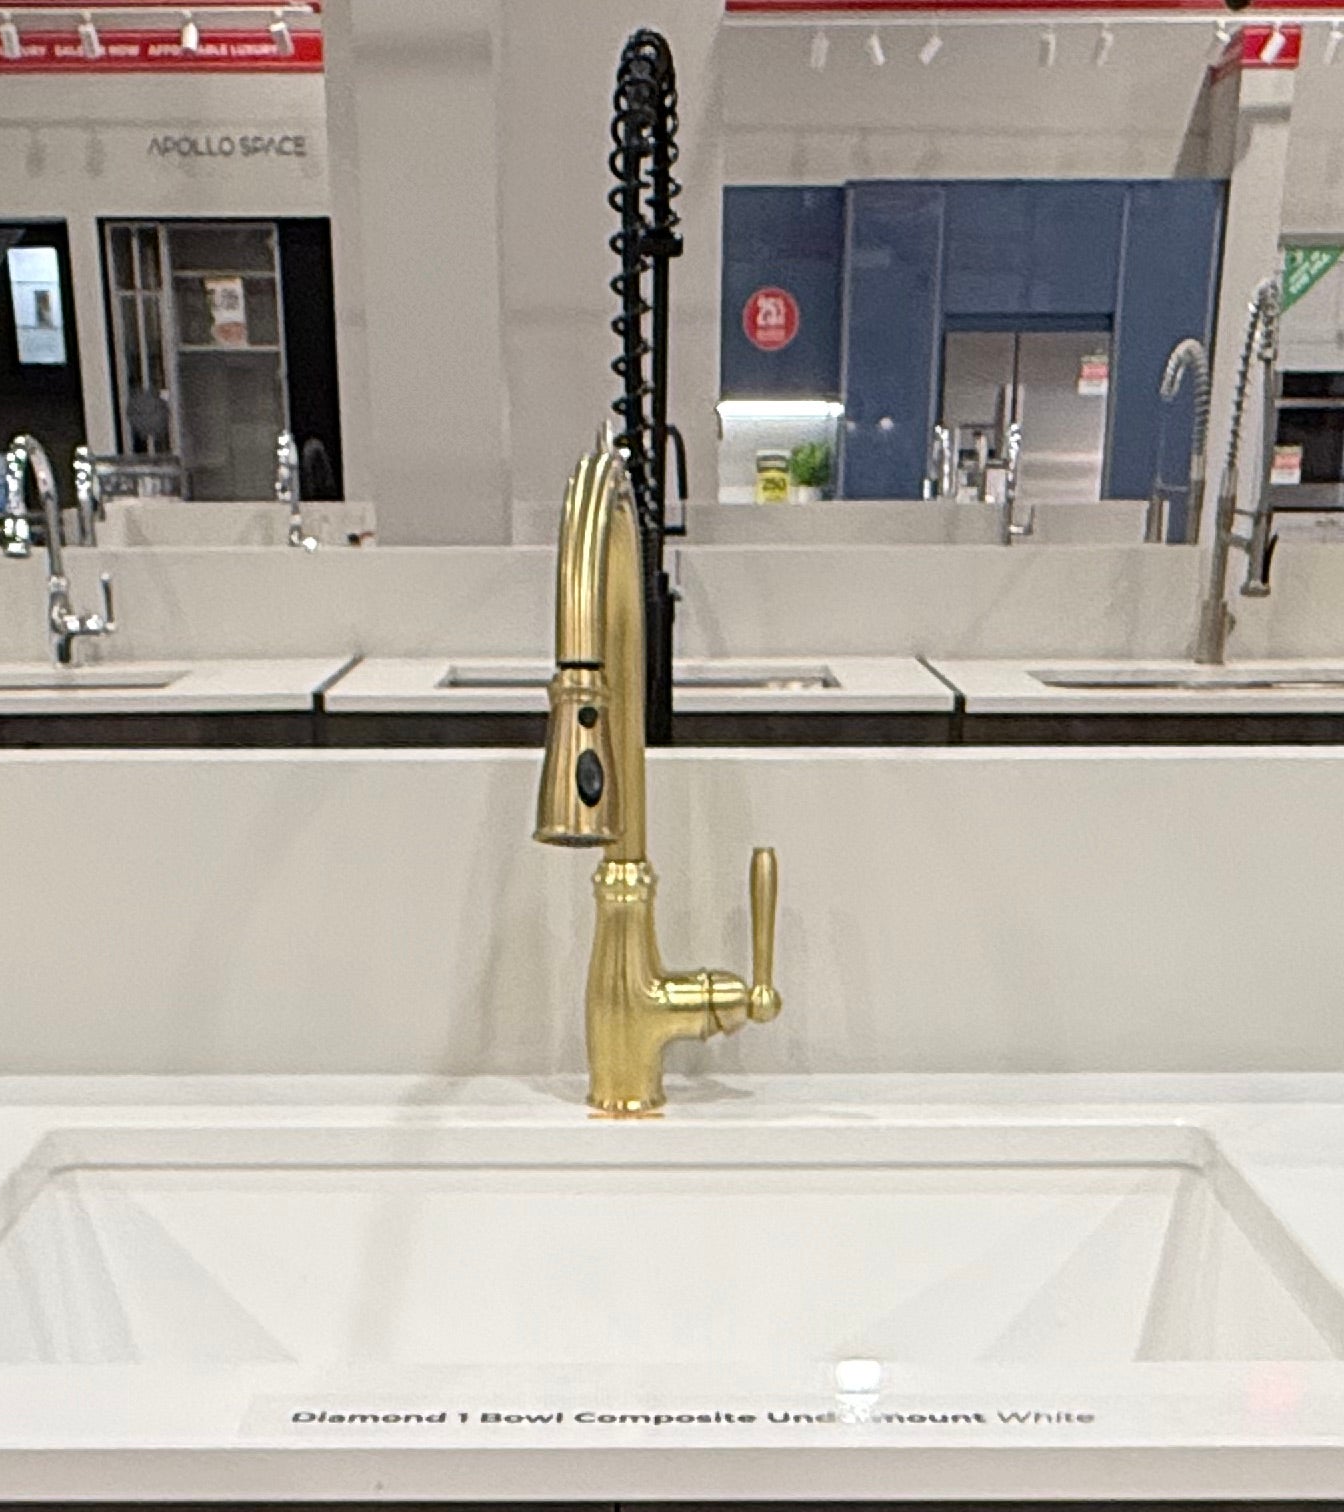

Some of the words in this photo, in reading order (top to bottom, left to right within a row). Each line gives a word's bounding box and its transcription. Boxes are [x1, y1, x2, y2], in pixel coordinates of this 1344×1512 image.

[147, 135, 235, 157] APOLLO
[238, 135, 307, 157] SPACE
[291, 1410, 448, 1424] Diamond
[458, 1411, 469, 1424] 1
[479, 1410, 564, 1424] Bowl
[573, 1409, 758, 1427] Composite
[766, 1410, 987, 1425] Undmount
[996, 1410, 1097, 1424] White
